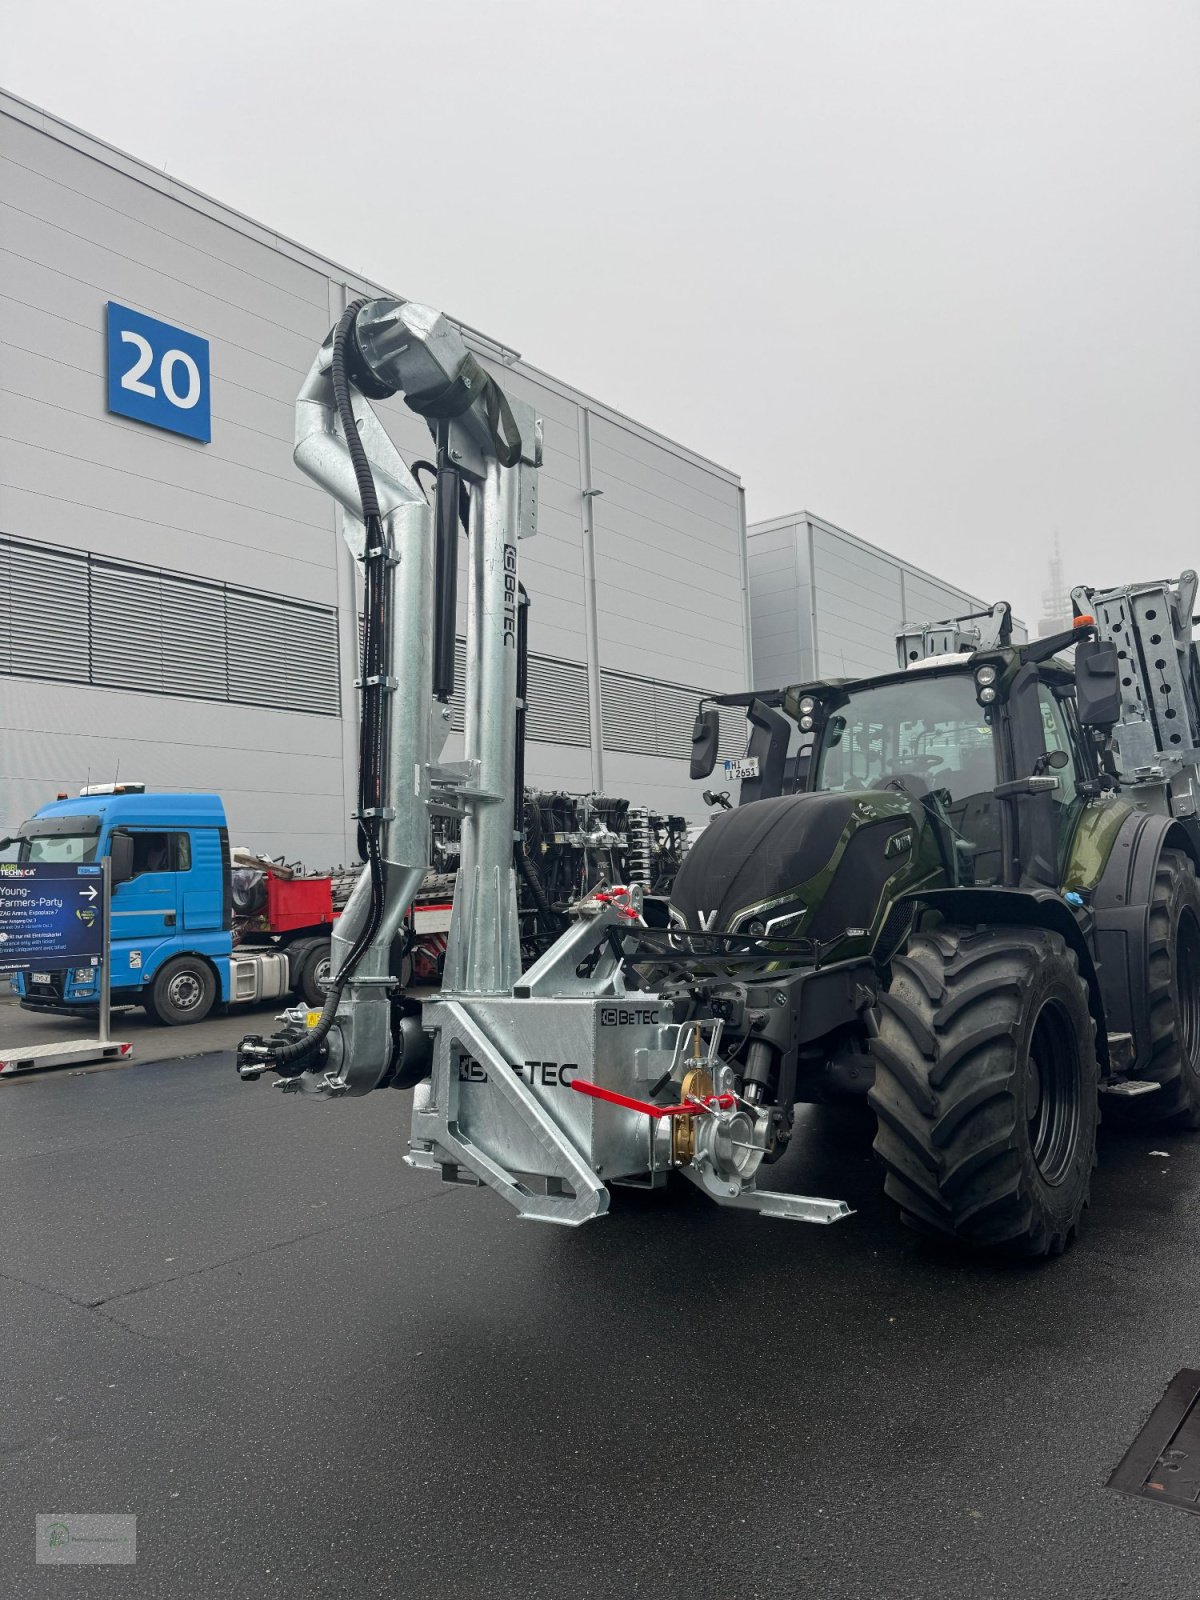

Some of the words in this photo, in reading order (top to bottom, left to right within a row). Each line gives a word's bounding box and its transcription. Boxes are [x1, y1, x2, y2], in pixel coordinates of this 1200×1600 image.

[120, 330, 201, 409] 20
[732, 761, 741, 770] HI
[736, 768, 755, 778] 2651
[0, 887, 31, 897] Young-
[0, 898, 62, 908] Farmers-Party
